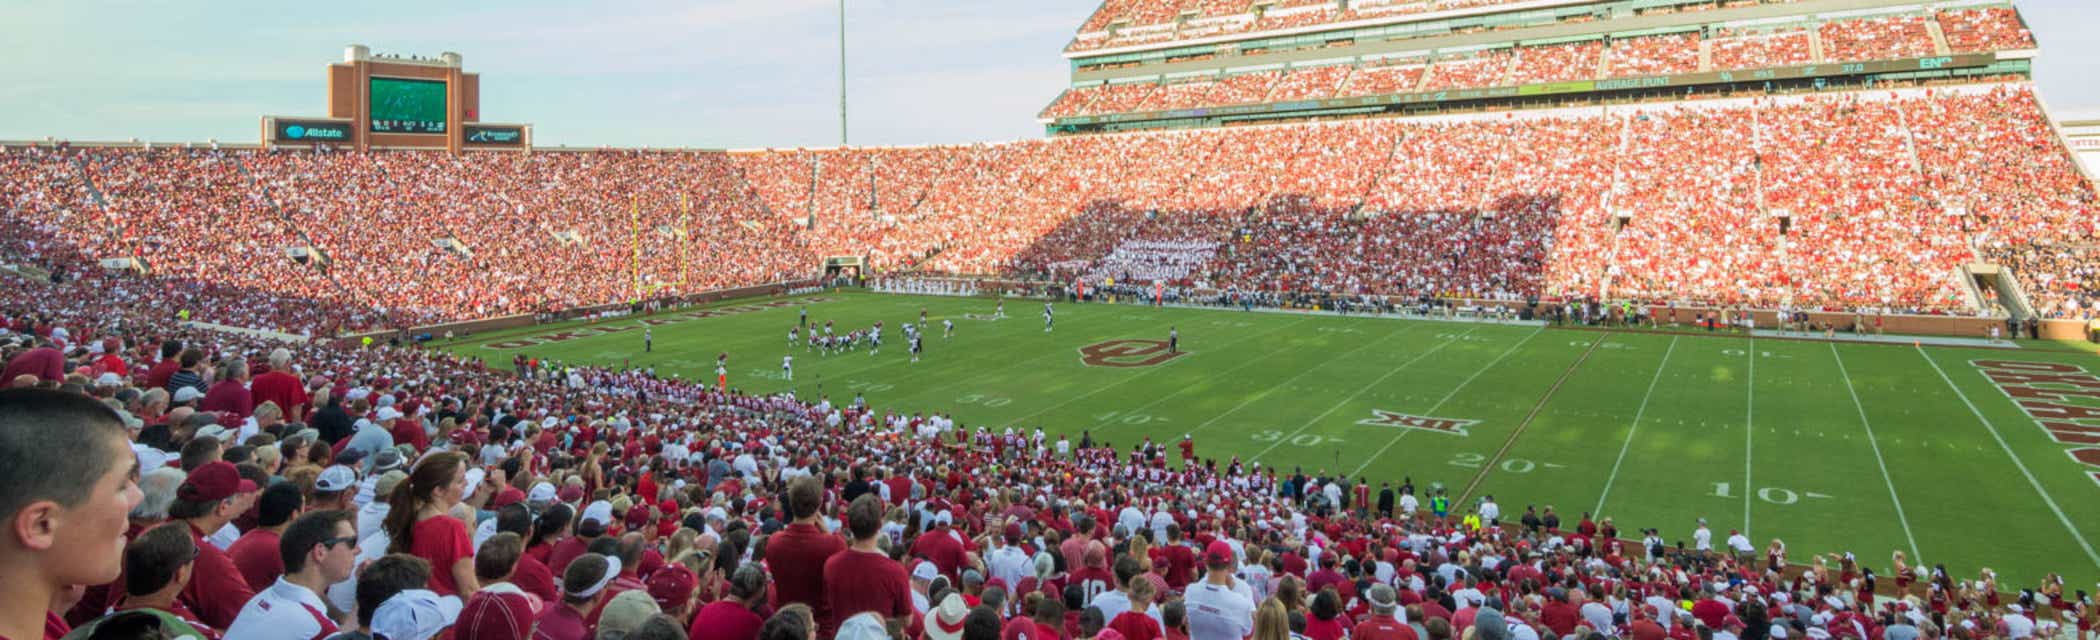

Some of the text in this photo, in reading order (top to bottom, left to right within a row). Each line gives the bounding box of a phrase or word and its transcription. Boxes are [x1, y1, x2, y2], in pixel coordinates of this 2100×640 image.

[304, 128, 343, 137] Allstate
[1446, 452, 1536, 473] 20
[1704, 481, 1798, 504] 10
